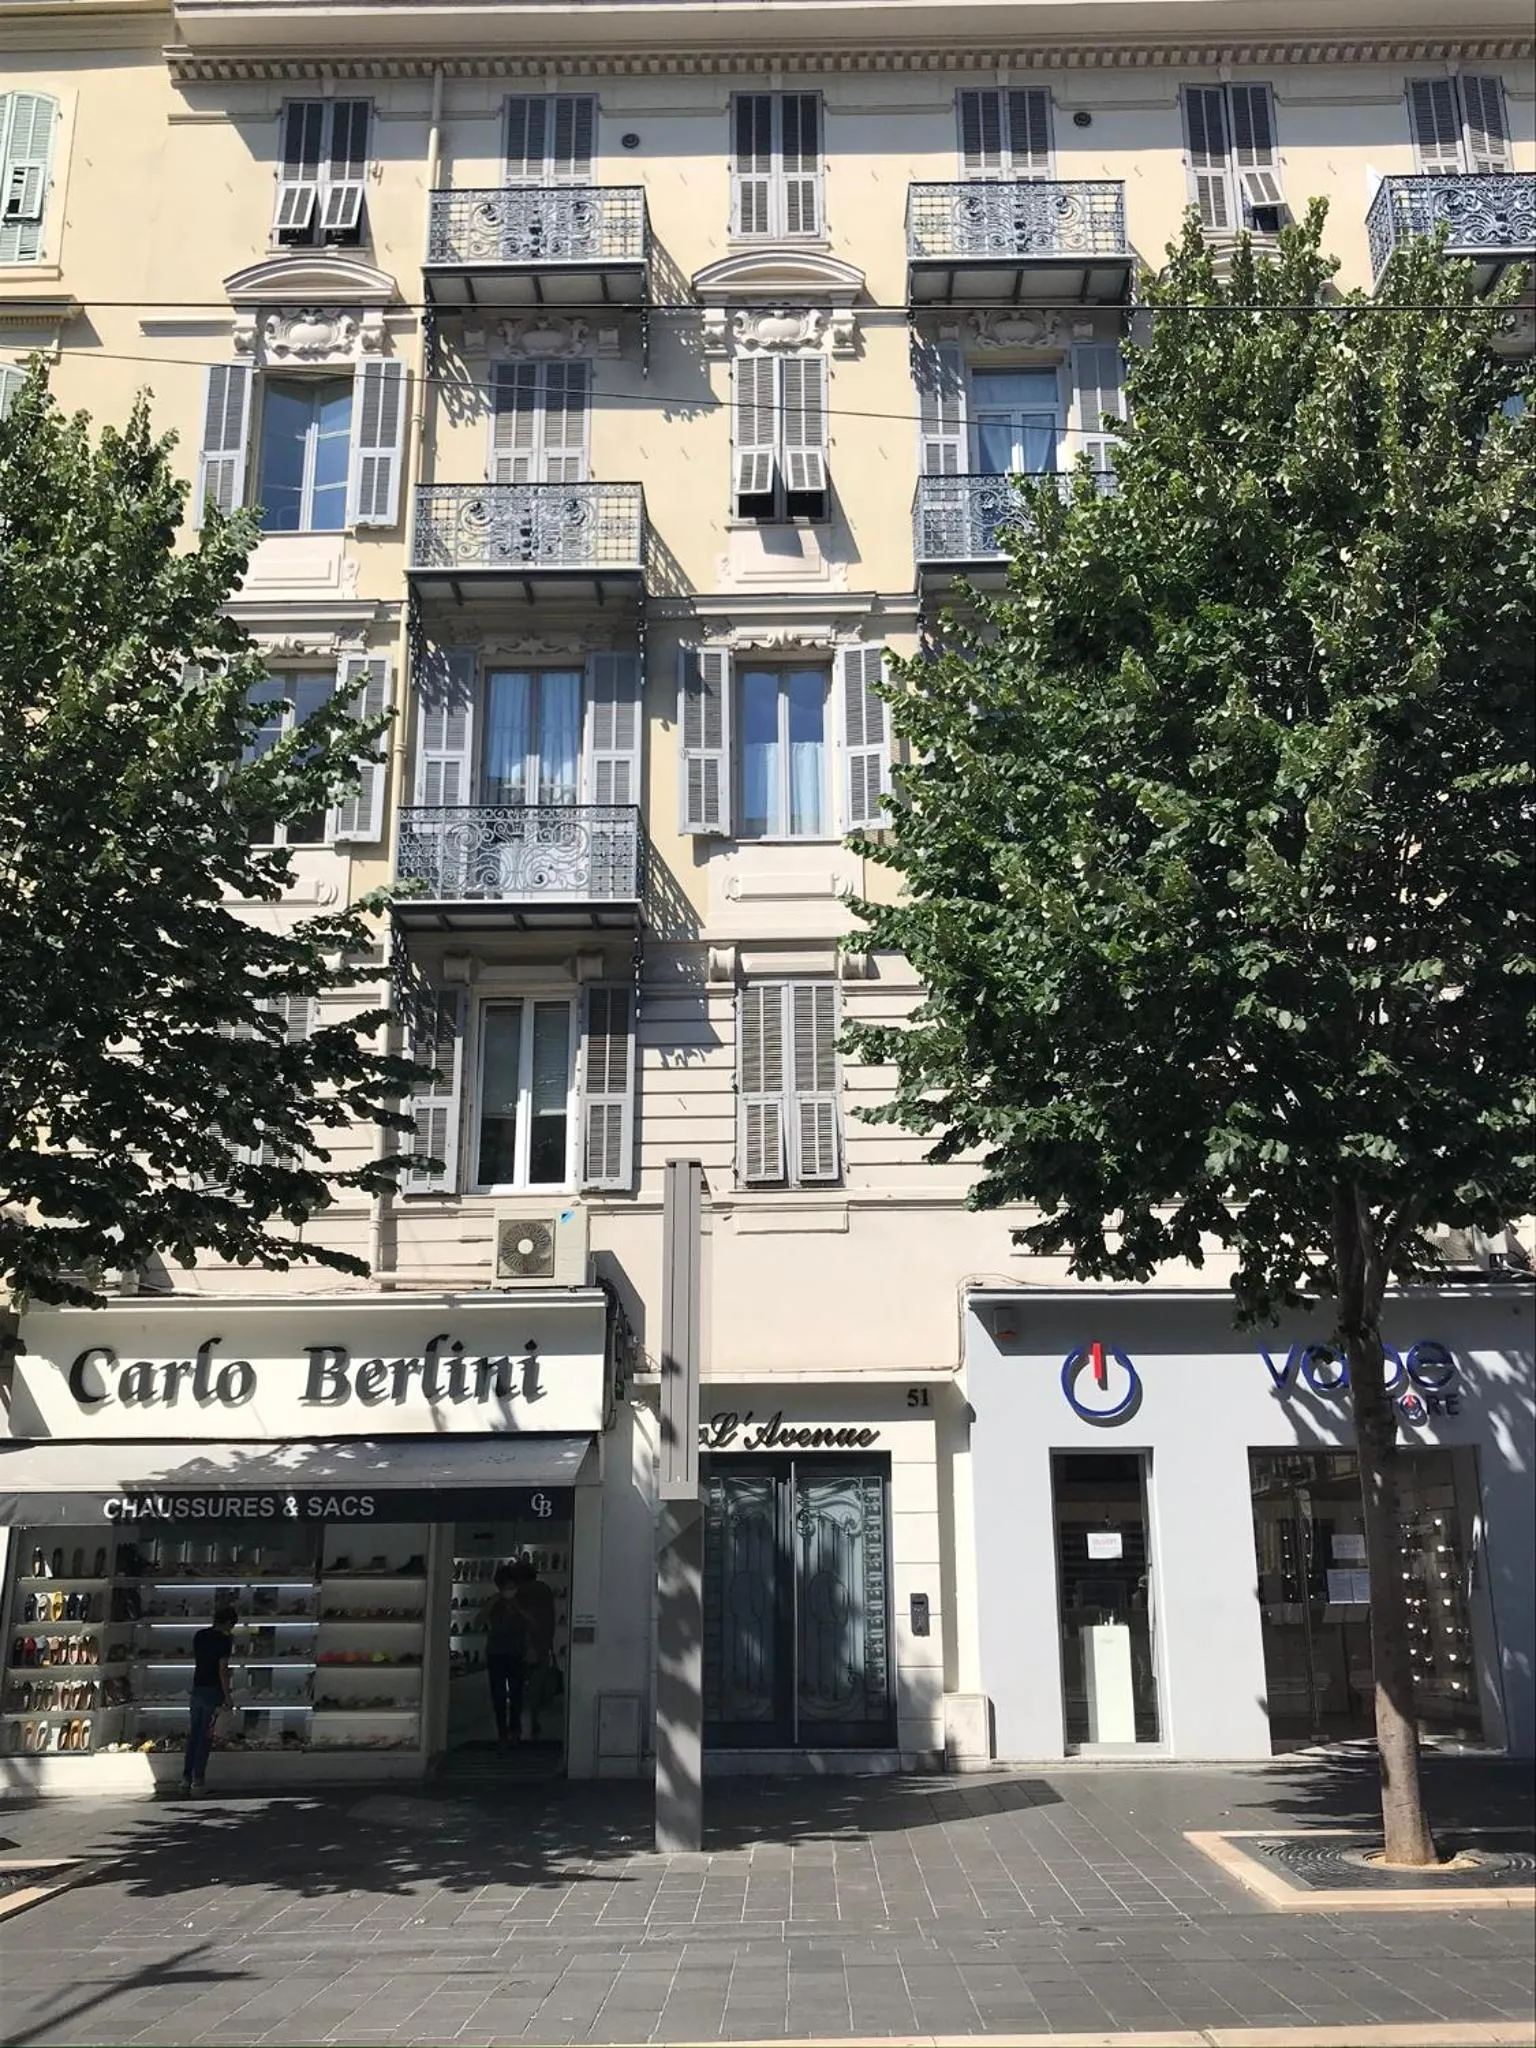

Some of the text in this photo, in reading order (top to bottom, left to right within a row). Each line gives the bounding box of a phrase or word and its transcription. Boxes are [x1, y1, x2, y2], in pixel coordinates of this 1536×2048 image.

[69, 1333, 546, 1406] Carlo Berlini
[907, 1388, 929, 1407] 51
[103, 1496, 375, 1518] CHAUSSURES & SACS
